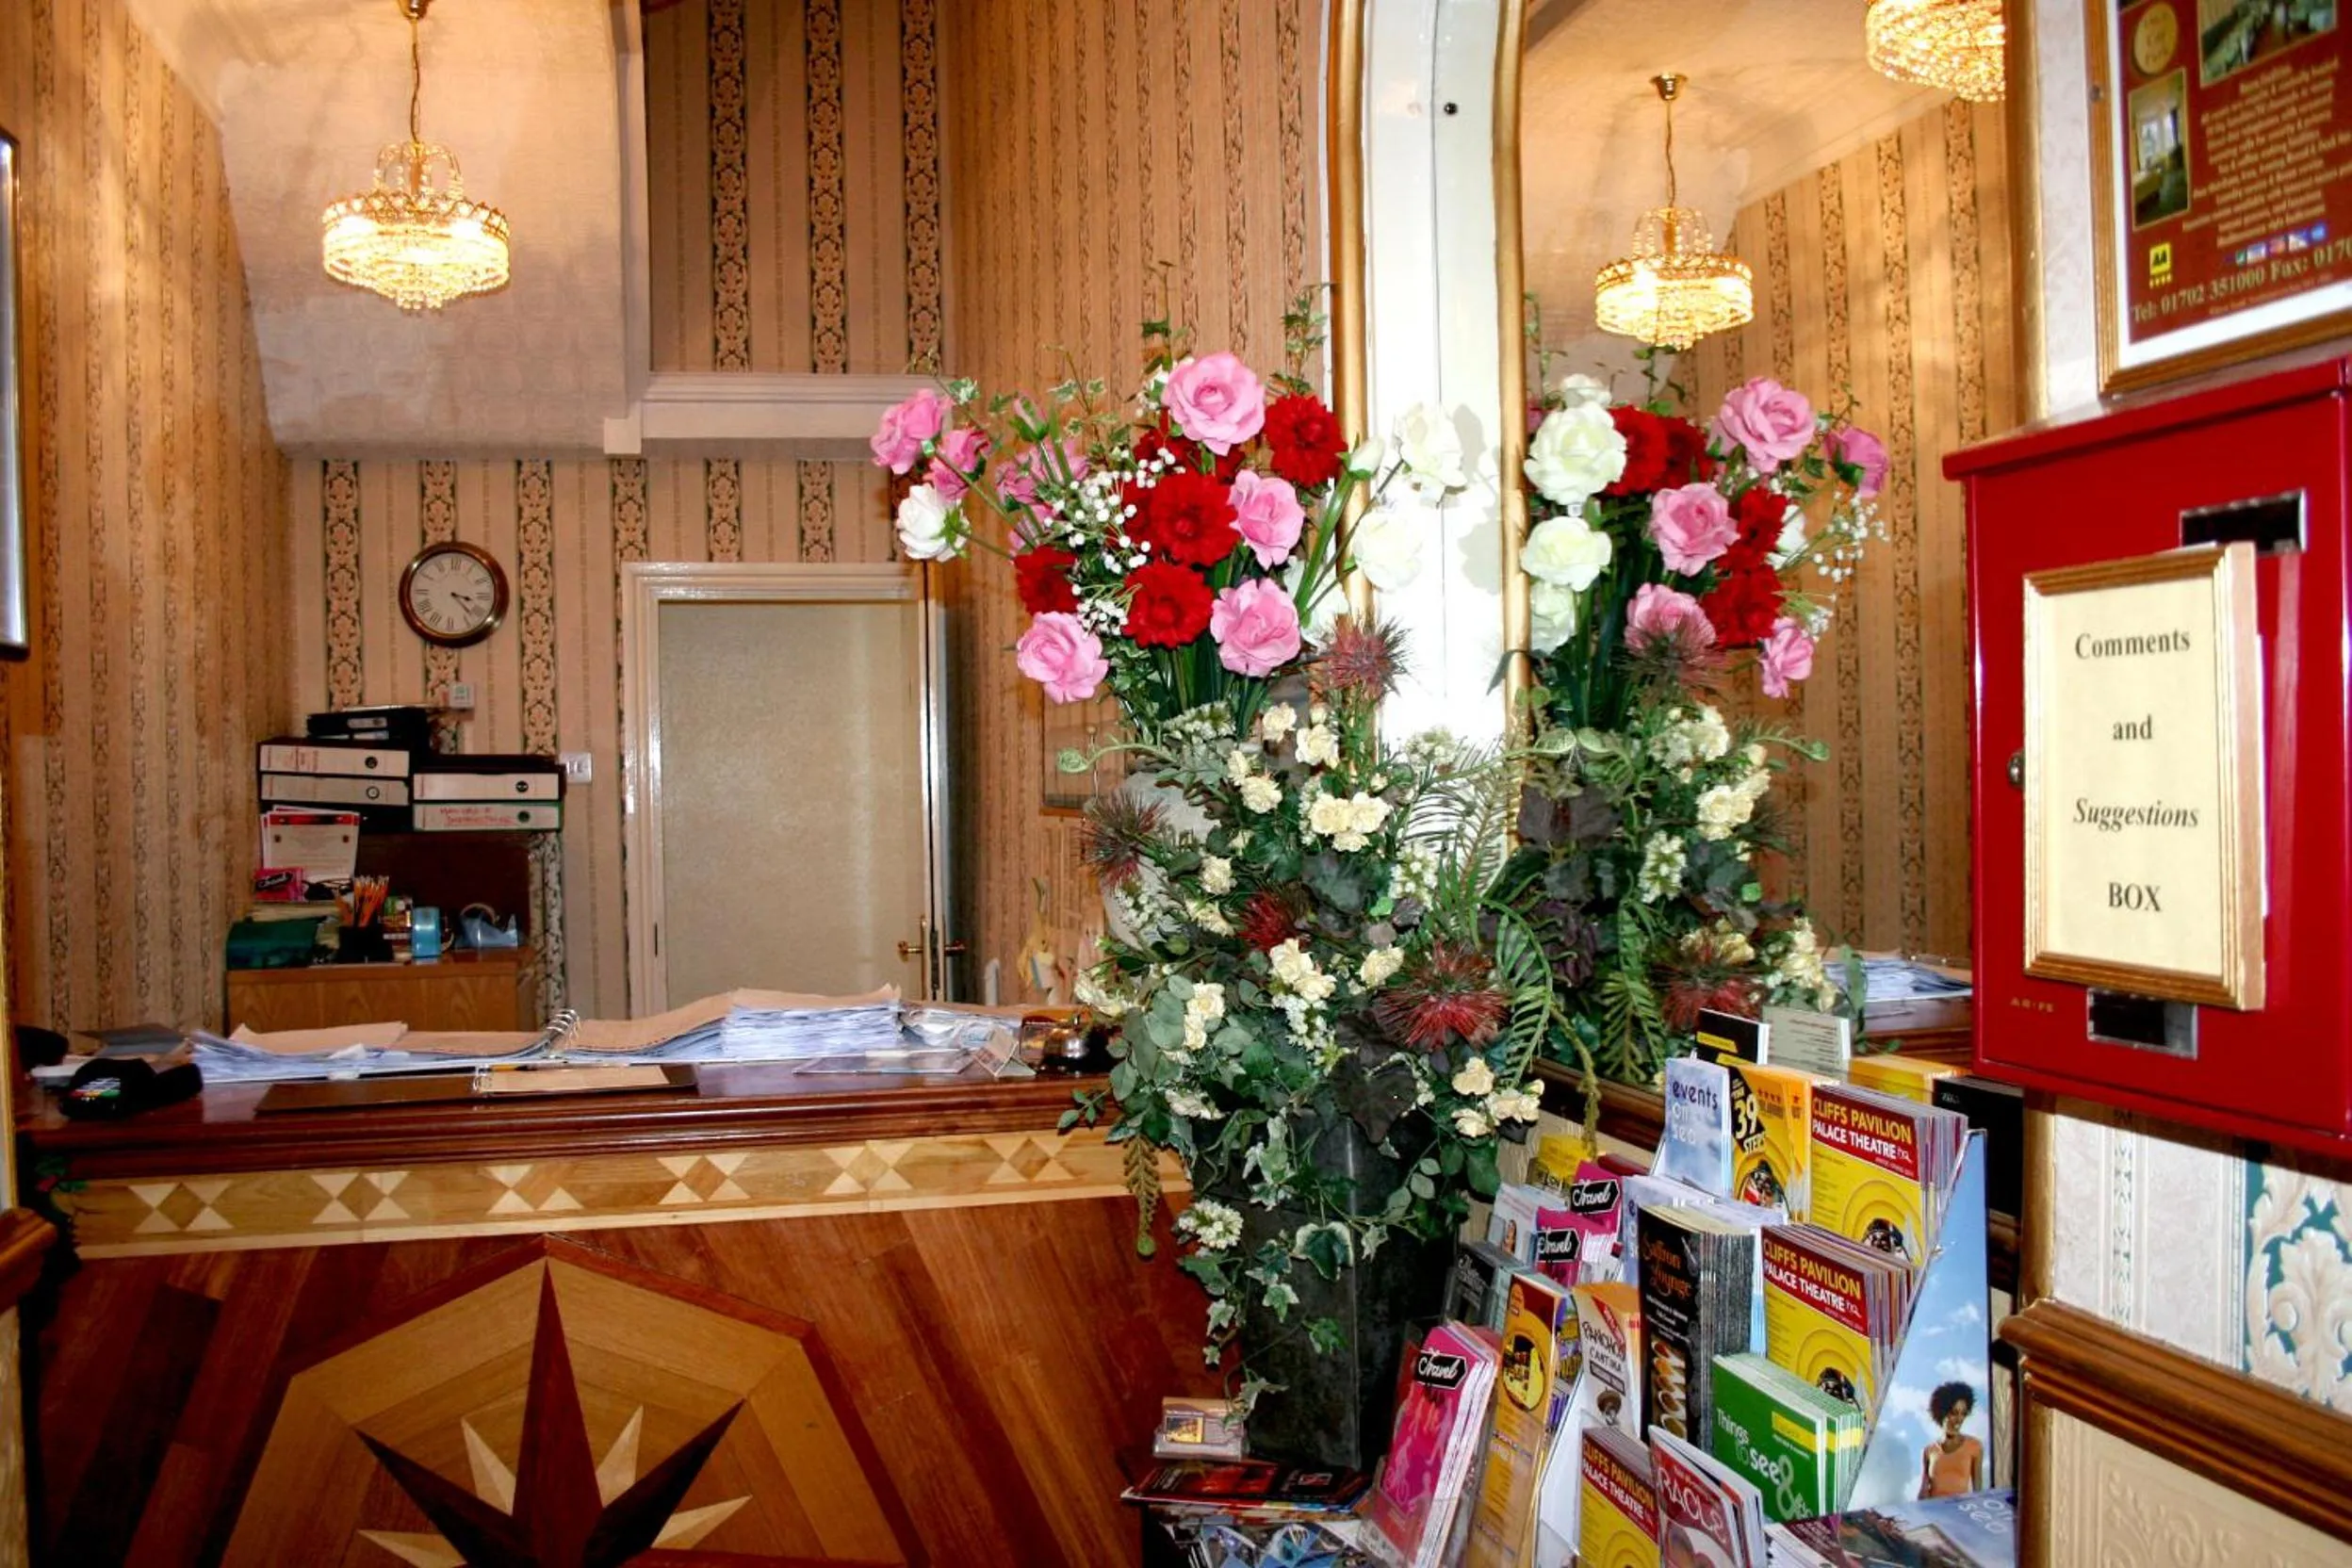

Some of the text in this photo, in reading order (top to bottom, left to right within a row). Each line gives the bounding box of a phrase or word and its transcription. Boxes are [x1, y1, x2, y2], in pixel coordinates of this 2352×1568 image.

[2161, 285, 2205, 313] 01702
[2270, 256, 2309, 282] Fax:
[2075, 627, 2191, 660] Comments
[2113, 713, 2152, 741] and
[2073, 797, 2200, 832] Suggestions
[2108, 881, 2162, 911] BOX
[1673, 1080, 1718, 1111] events
[1735, 1093, 1759, 1139] 39
[1813, 1097, 1848, 1125] CLIFFS
[1851, 1108, 1912, 1146] PAVILION
[1812, 1119, 1848, 1143] PALACE
[1849, 1130, 1897, 1160] THEATRE
[1763, 1238, 1862, 1300] CLIFFS PAVILION
[1763, 1260, 1798, 1290] PALACE
[1799, 1277, 1846, 1314] THEATRE
[1717, 1408, 1750, 1446] Things
[1750, 1446, 1782, 1486] see
[1609, 1480, 1644, 1519] THEATRE
[1611, 1462, 1655, 1512] PAVILION
